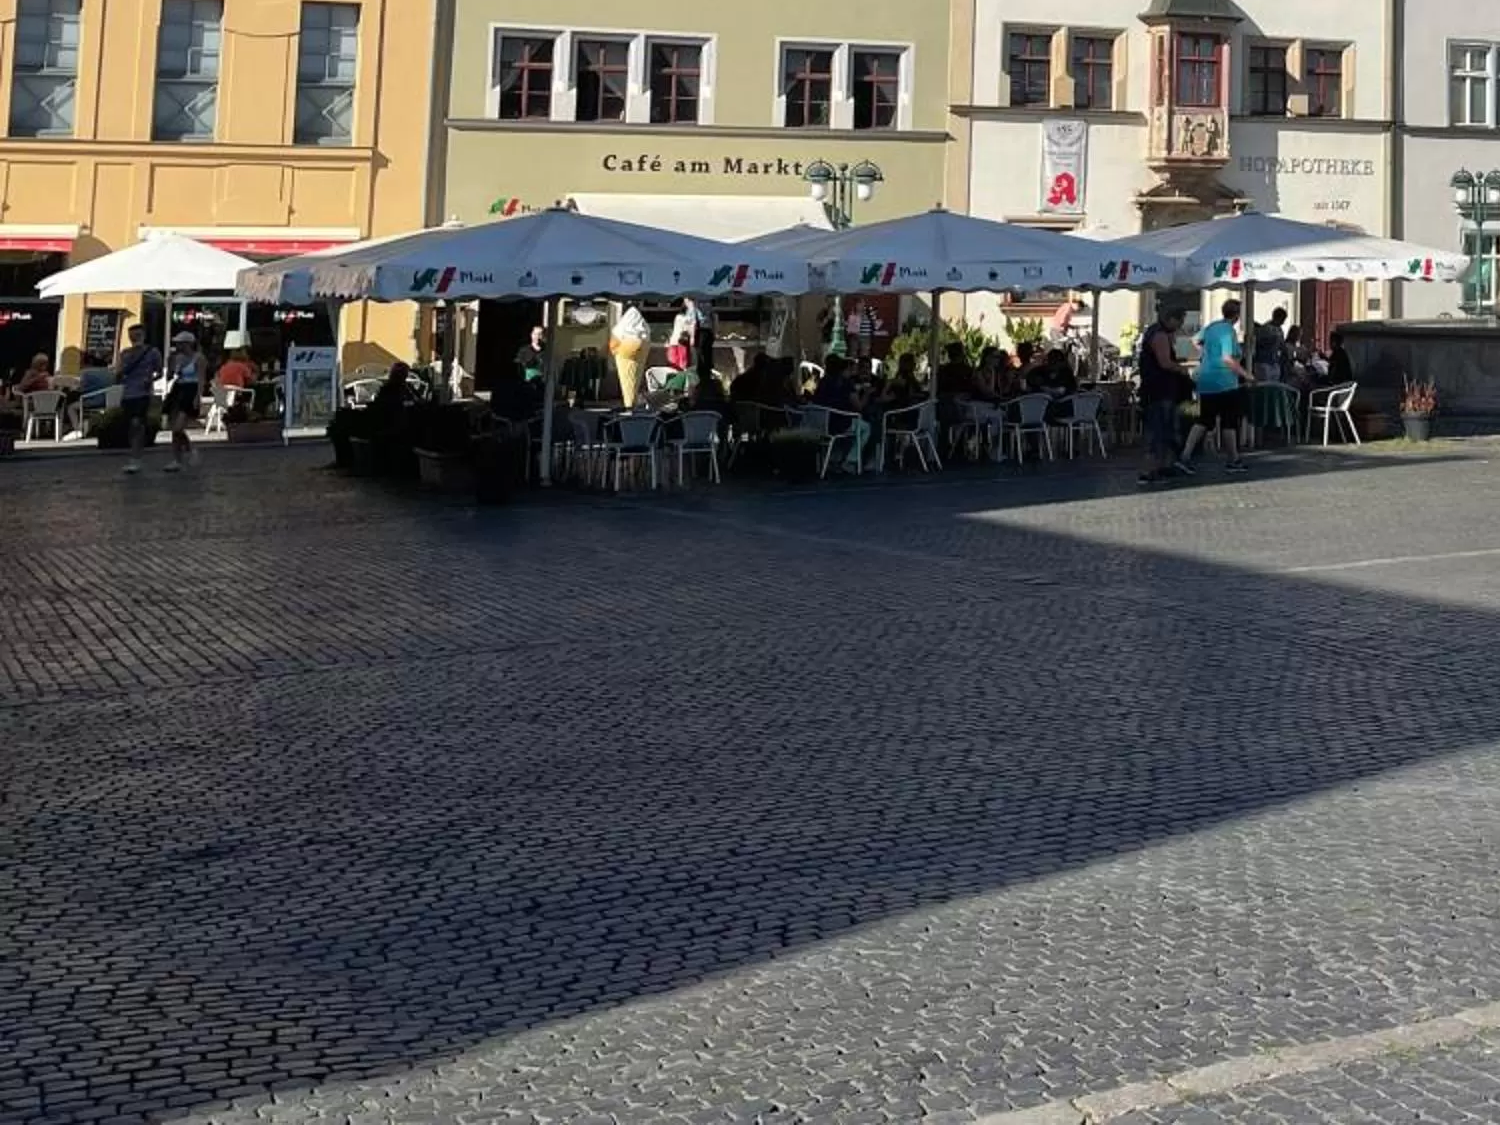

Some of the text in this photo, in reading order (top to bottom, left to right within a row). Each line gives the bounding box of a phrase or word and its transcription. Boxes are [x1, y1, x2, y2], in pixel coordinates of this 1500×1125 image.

[602, 154, 803, 176] Café am Markt
[1239, 156, 1375, 176] HOFAPOTHEKE
